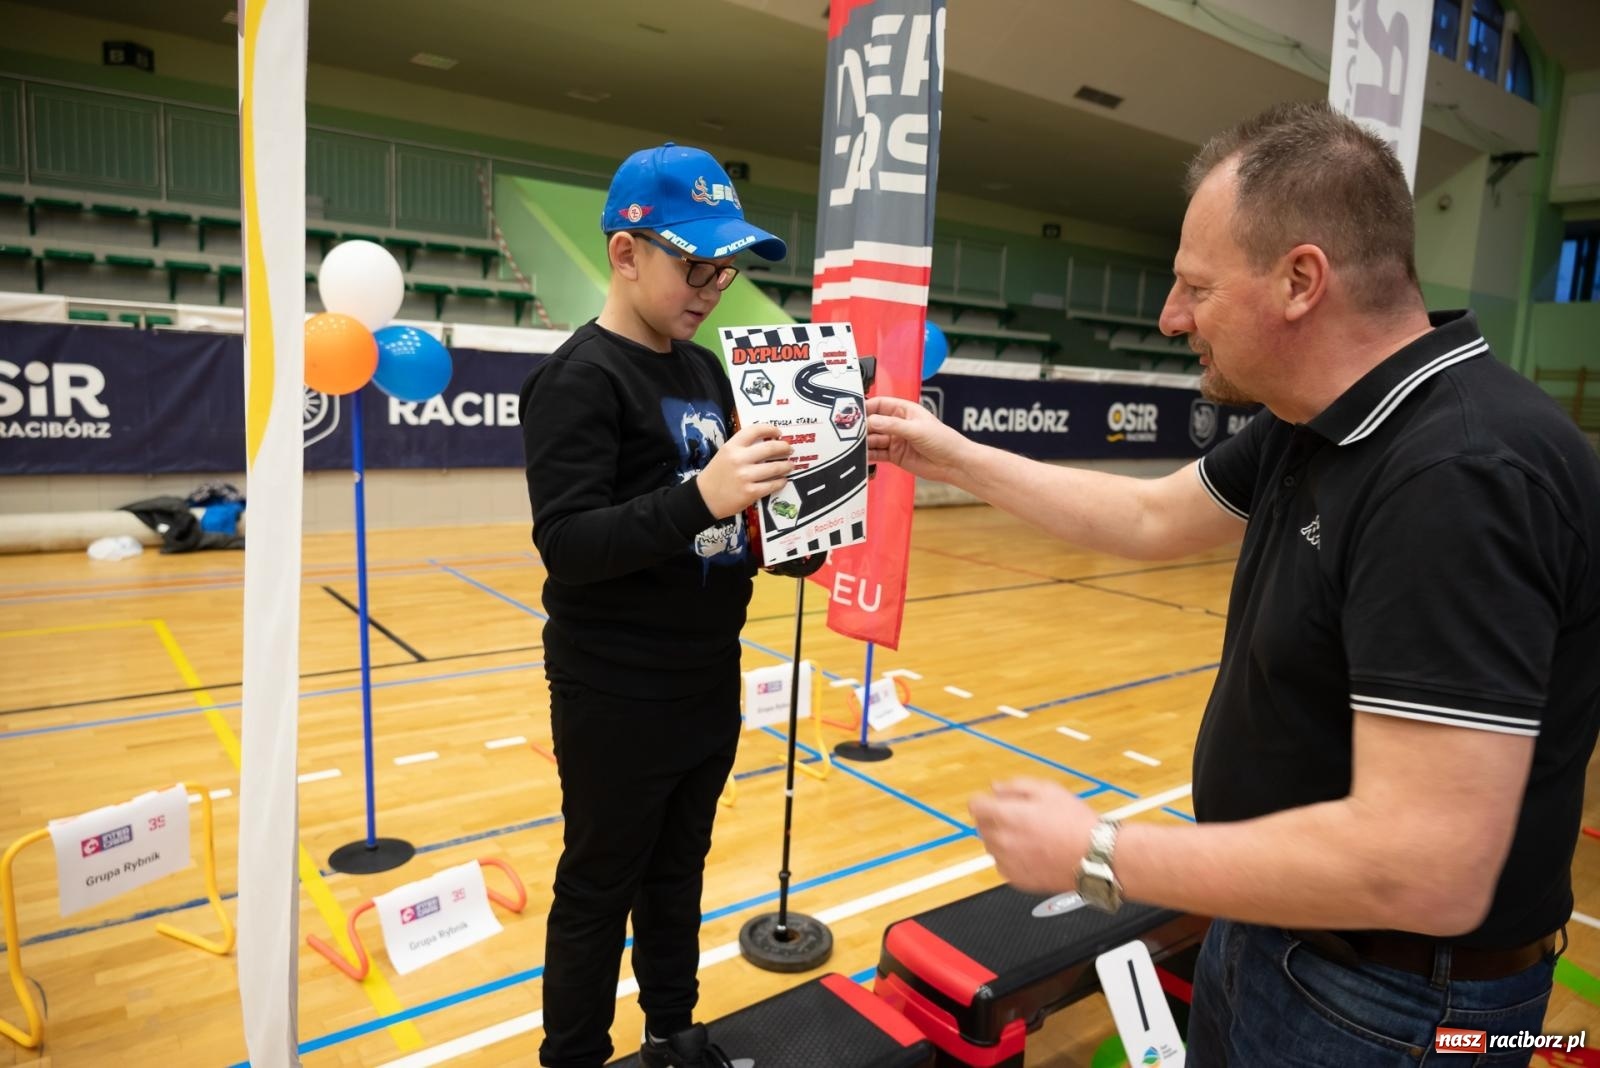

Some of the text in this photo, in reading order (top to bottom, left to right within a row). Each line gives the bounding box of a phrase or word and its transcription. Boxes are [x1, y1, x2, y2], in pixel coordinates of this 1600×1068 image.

[732, 343, 810, 365] DYPLOM
[962, 402, 1069, 433] RACIBÓRZ
[86, 851, 160, 887] Grupa Rybnik
[409, 921, 468, 951] Grupa Rybnik
